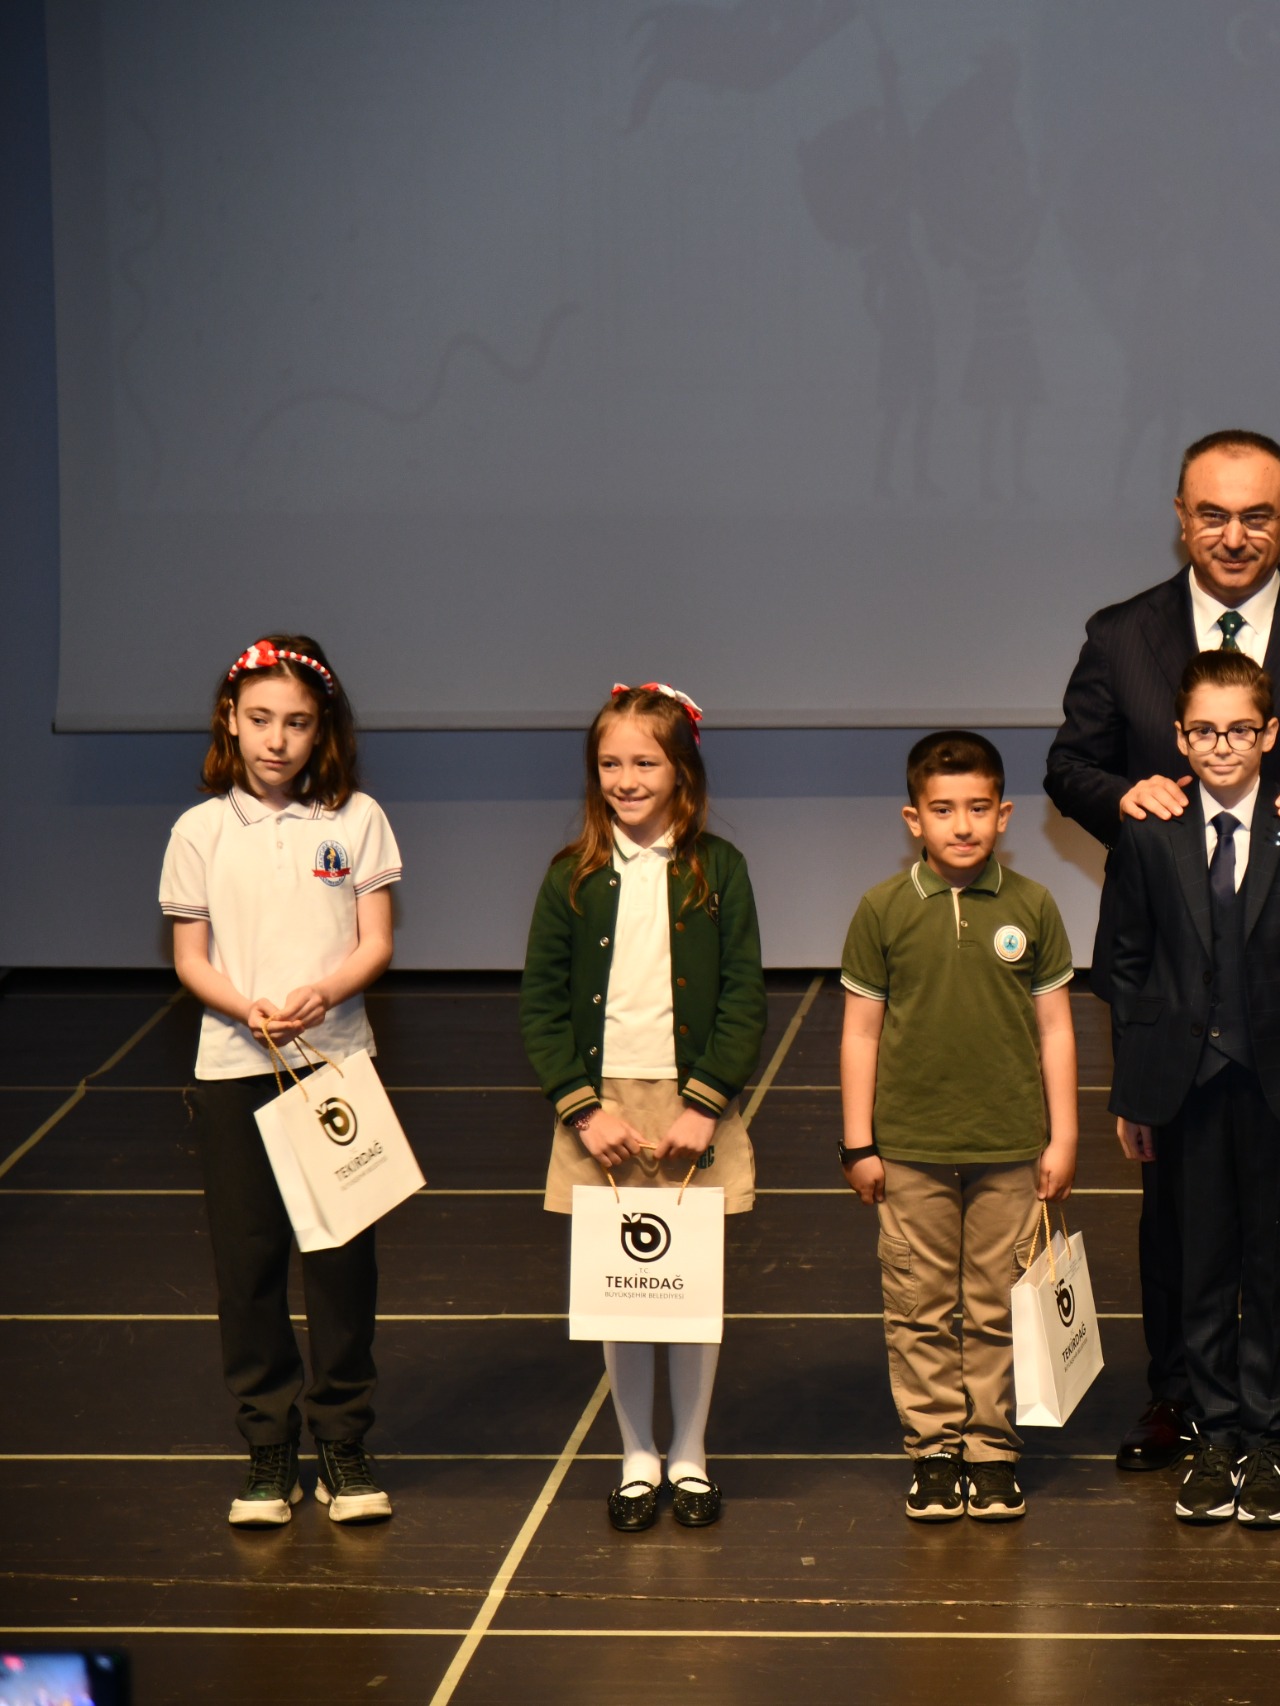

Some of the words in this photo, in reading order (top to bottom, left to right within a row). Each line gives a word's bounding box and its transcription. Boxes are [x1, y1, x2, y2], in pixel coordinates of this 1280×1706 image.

[334, 1140, 383, 1181] TEKİRDAĞ
[604, 1290, 647, 1299] BÜYÜKŞEHİR
[648, 1292, 684, 1300] BELEDİYESİ
[605, 1273, 684, 1290] TEKİRDAĞ
[1062, 1321, 1086, 1362] TEKİRDAĞ
